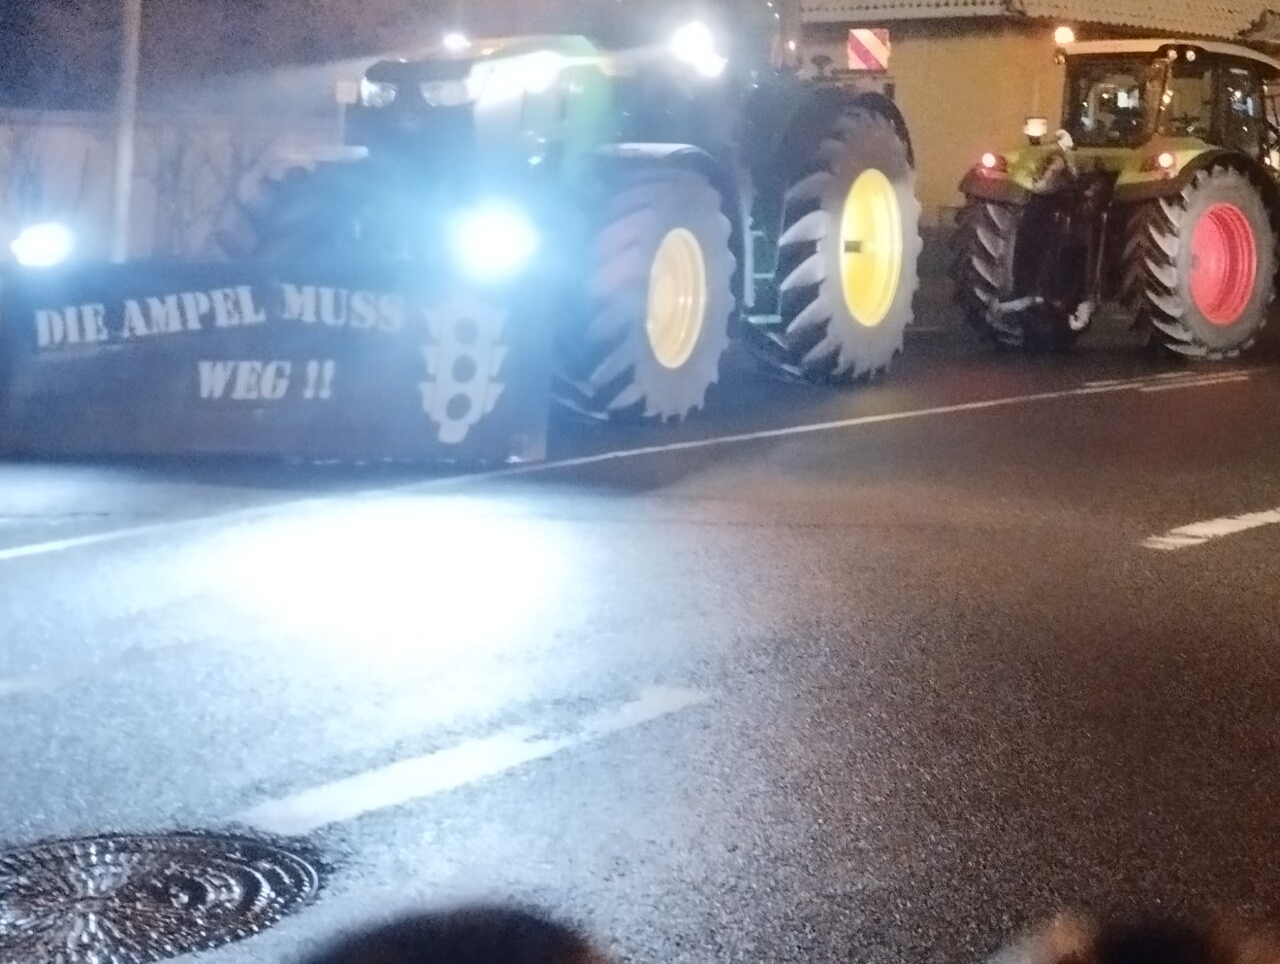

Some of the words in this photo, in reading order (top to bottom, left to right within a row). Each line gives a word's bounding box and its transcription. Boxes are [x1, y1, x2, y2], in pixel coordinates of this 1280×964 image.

[35, 302, 108, 348] DIE
[121, 284, 266, 338] AMPEL
[278, 282, 405, 332] MUSS
[197, 359, 292, 400] WEG
